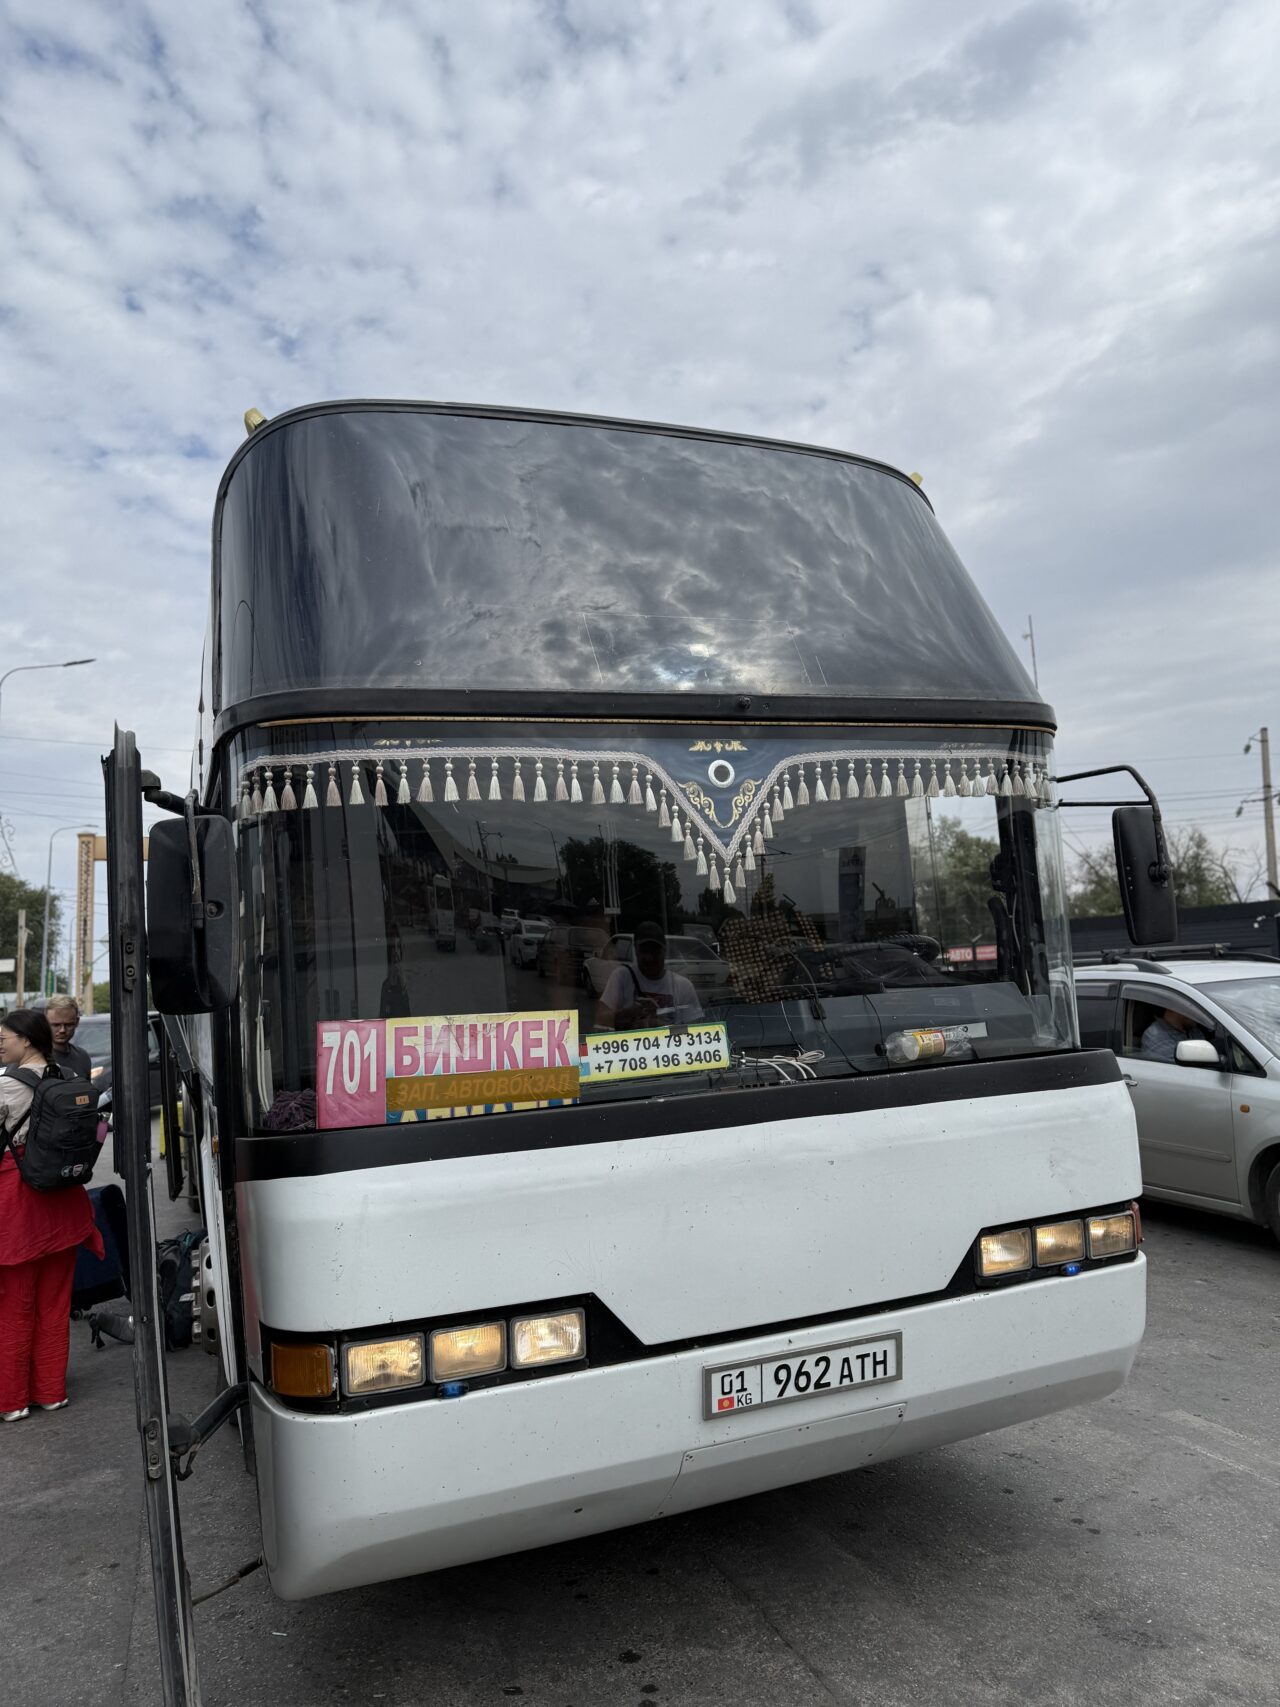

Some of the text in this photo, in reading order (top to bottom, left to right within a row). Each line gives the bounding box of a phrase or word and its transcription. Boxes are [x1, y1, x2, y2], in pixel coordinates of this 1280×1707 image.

[592, 1030, 722, 1055] +996 704 79 3134
[322, 1018, 573, 1096] 701 БИШКЕК
[594, 1049, 722, 1074] +7 708 196 3406
[397, 1073, 572, 1103] ЗАП. АВТОВОКЗАЛ
[720, 1349, 888, 1398] 01 962 ATH
[736, 1392, 753, 1408] KG
